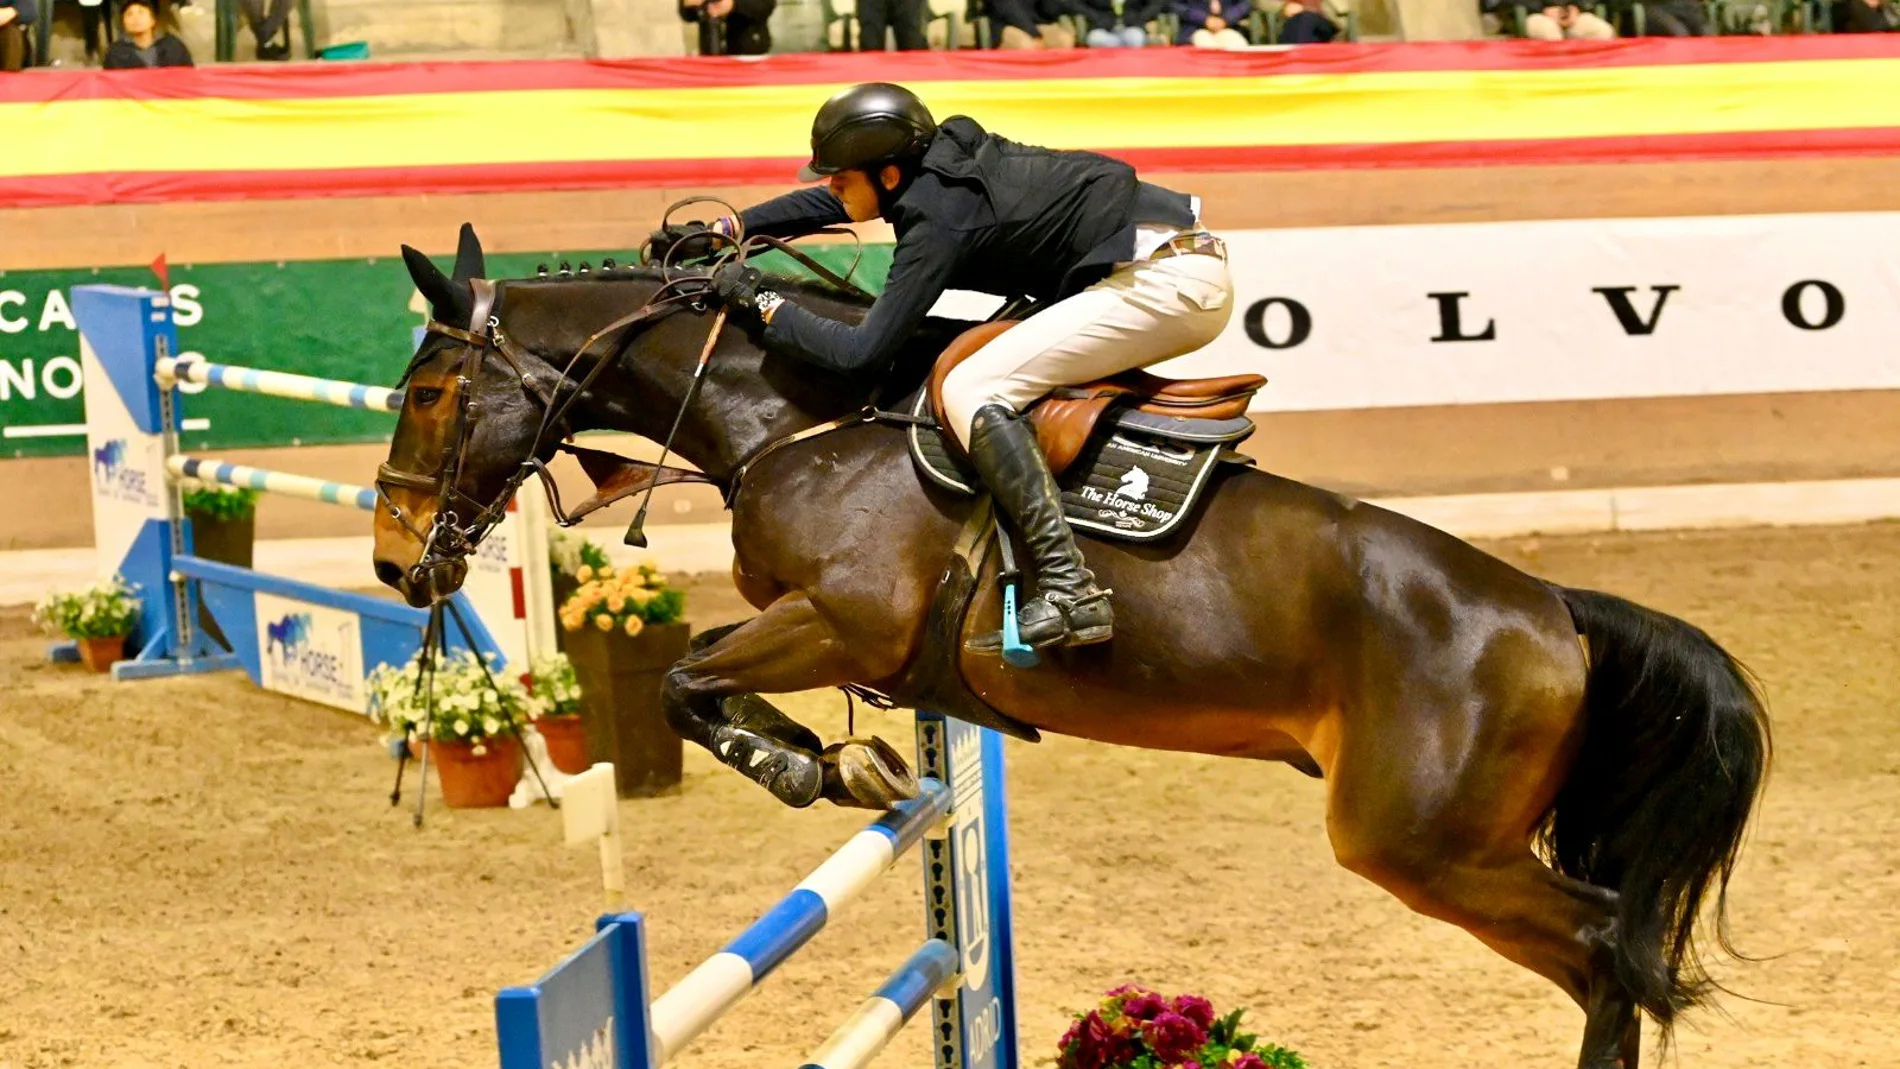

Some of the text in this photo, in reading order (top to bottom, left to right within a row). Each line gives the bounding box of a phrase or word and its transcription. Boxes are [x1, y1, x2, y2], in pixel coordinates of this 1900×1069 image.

[1243, 279, 1846, 349] OLVO
[1081, 485, 1173, 524] The Horse Shop
[478, 534, 507, 562] ORSE
[968, 995, 1002, 1069] ADRID
